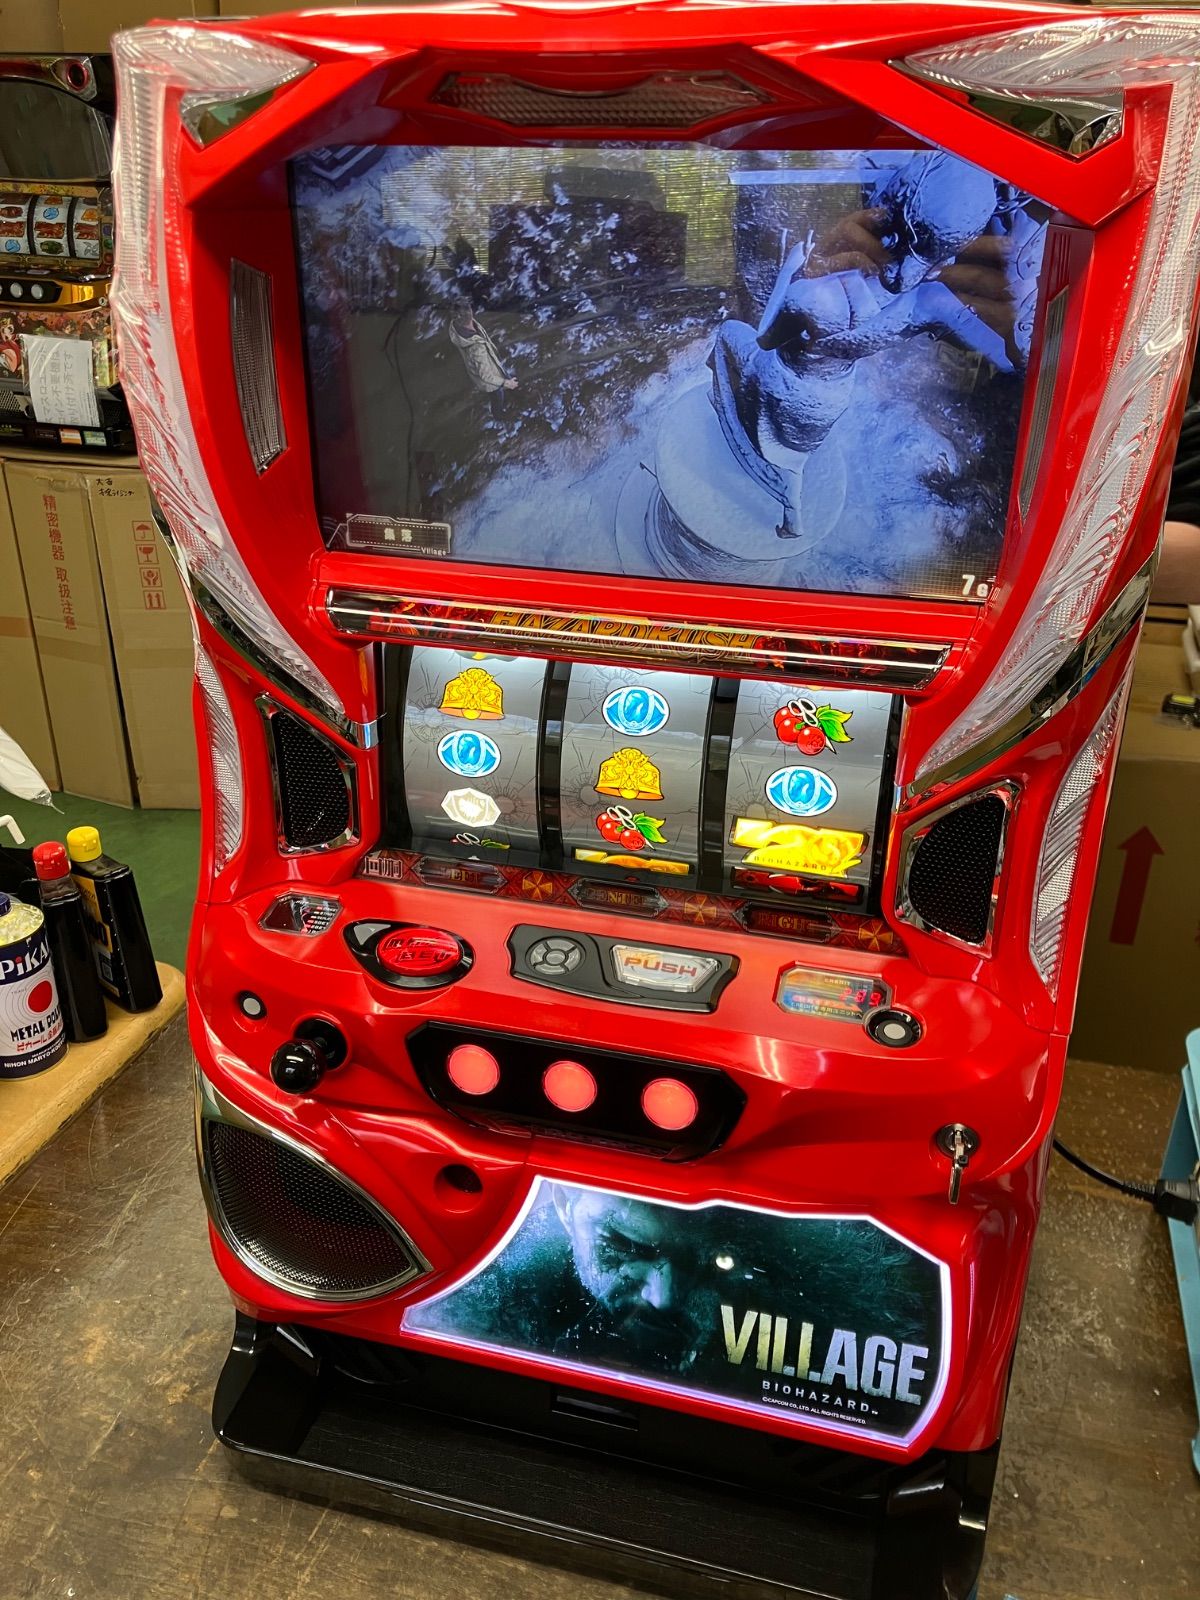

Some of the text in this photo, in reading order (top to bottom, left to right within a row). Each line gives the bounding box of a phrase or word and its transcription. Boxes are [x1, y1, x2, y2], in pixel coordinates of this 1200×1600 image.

[42, 494, 77, 630] 精密機器 取扱注意
[753, 855, 827, 871] BIOHAZARD
[0, 936, 50, 980] PiKA
[624, 956, 698, 978] PUSH
[10, 1019, 46, 1042] METAL
[17, 1033, 48, 1052] ピカール
[4, 1059, 27, 1068] NIHON
[720, 1304, 929, 1406] VILLAGE
[821, 1409, 840, 1418] RIGHTS
